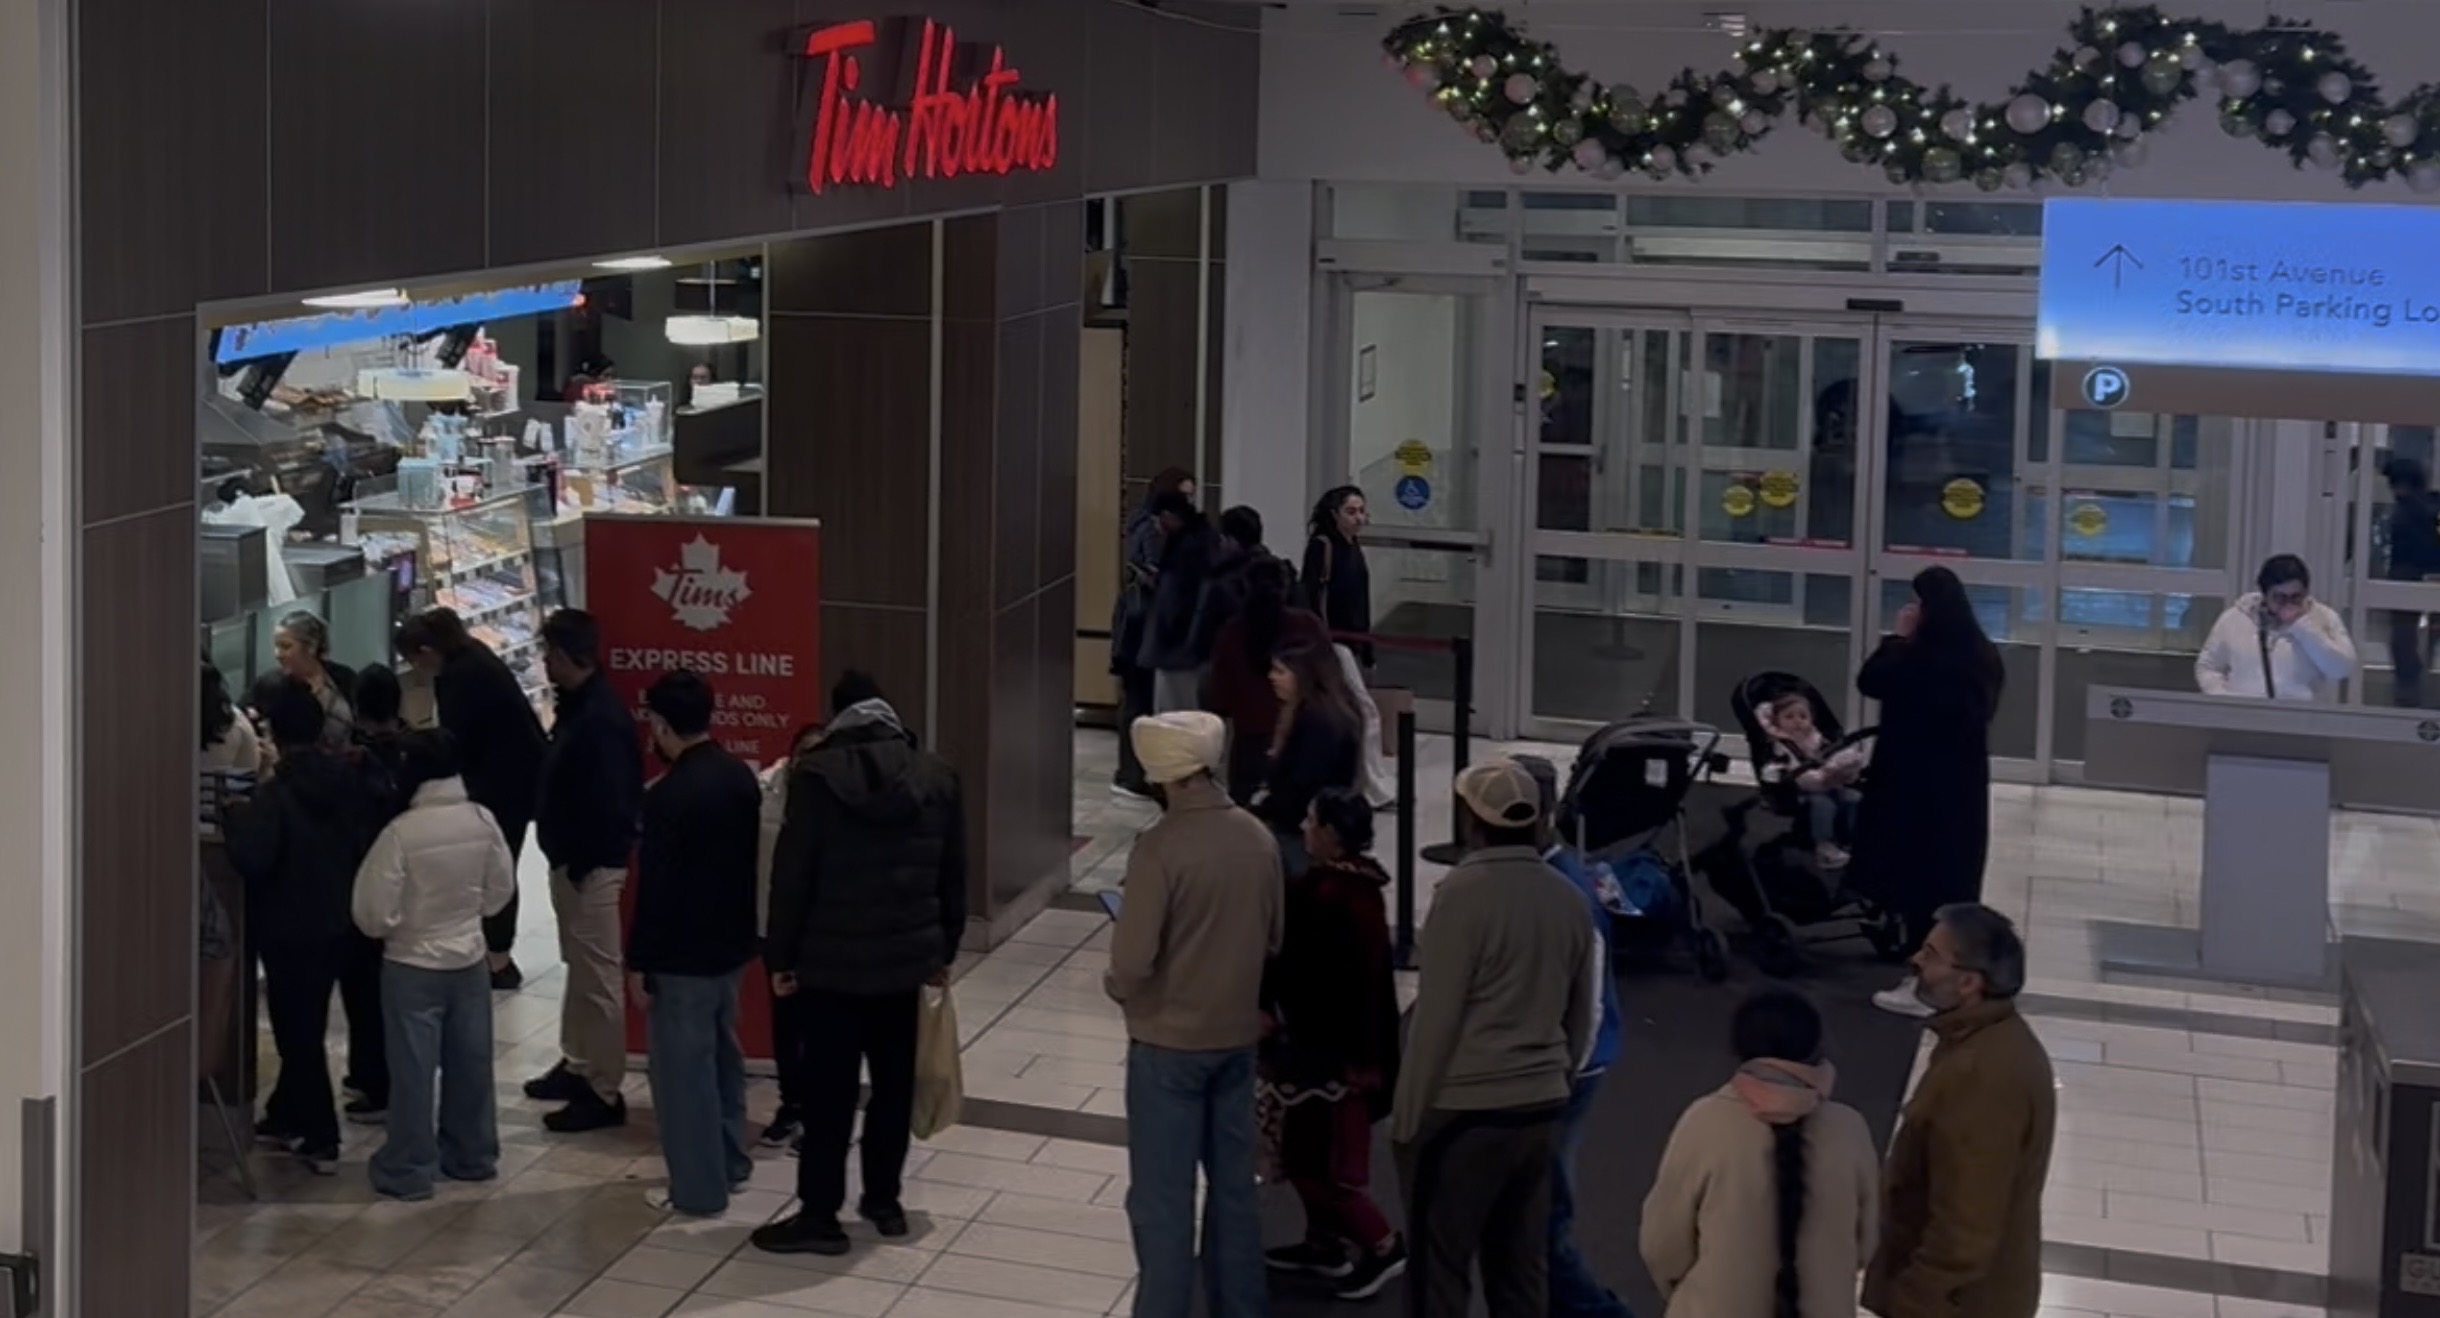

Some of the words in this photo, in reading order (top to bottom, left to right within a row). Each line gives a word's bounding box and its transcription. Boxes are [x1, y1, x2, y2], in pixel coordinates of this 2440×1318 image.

[806, 19, 900, 195] Tim
[903, 16, 1058, 179] Hortons
[2178, 255, 2259, 283] 101st
[2267, 260, 2386, 287] Avenue
[2176, 290, 2264, 317] South
[2277, 293, 2392, 328] Parking
[669, 567, 739, 609] Tims
[609, 648, 729, 674] EXPRESS
[736, 652, 795, 677] LINE
[728, 693, 767, 710] AND
[742, 711, 791, 730] ONLY
[725, 739, 760, 755] LINE
